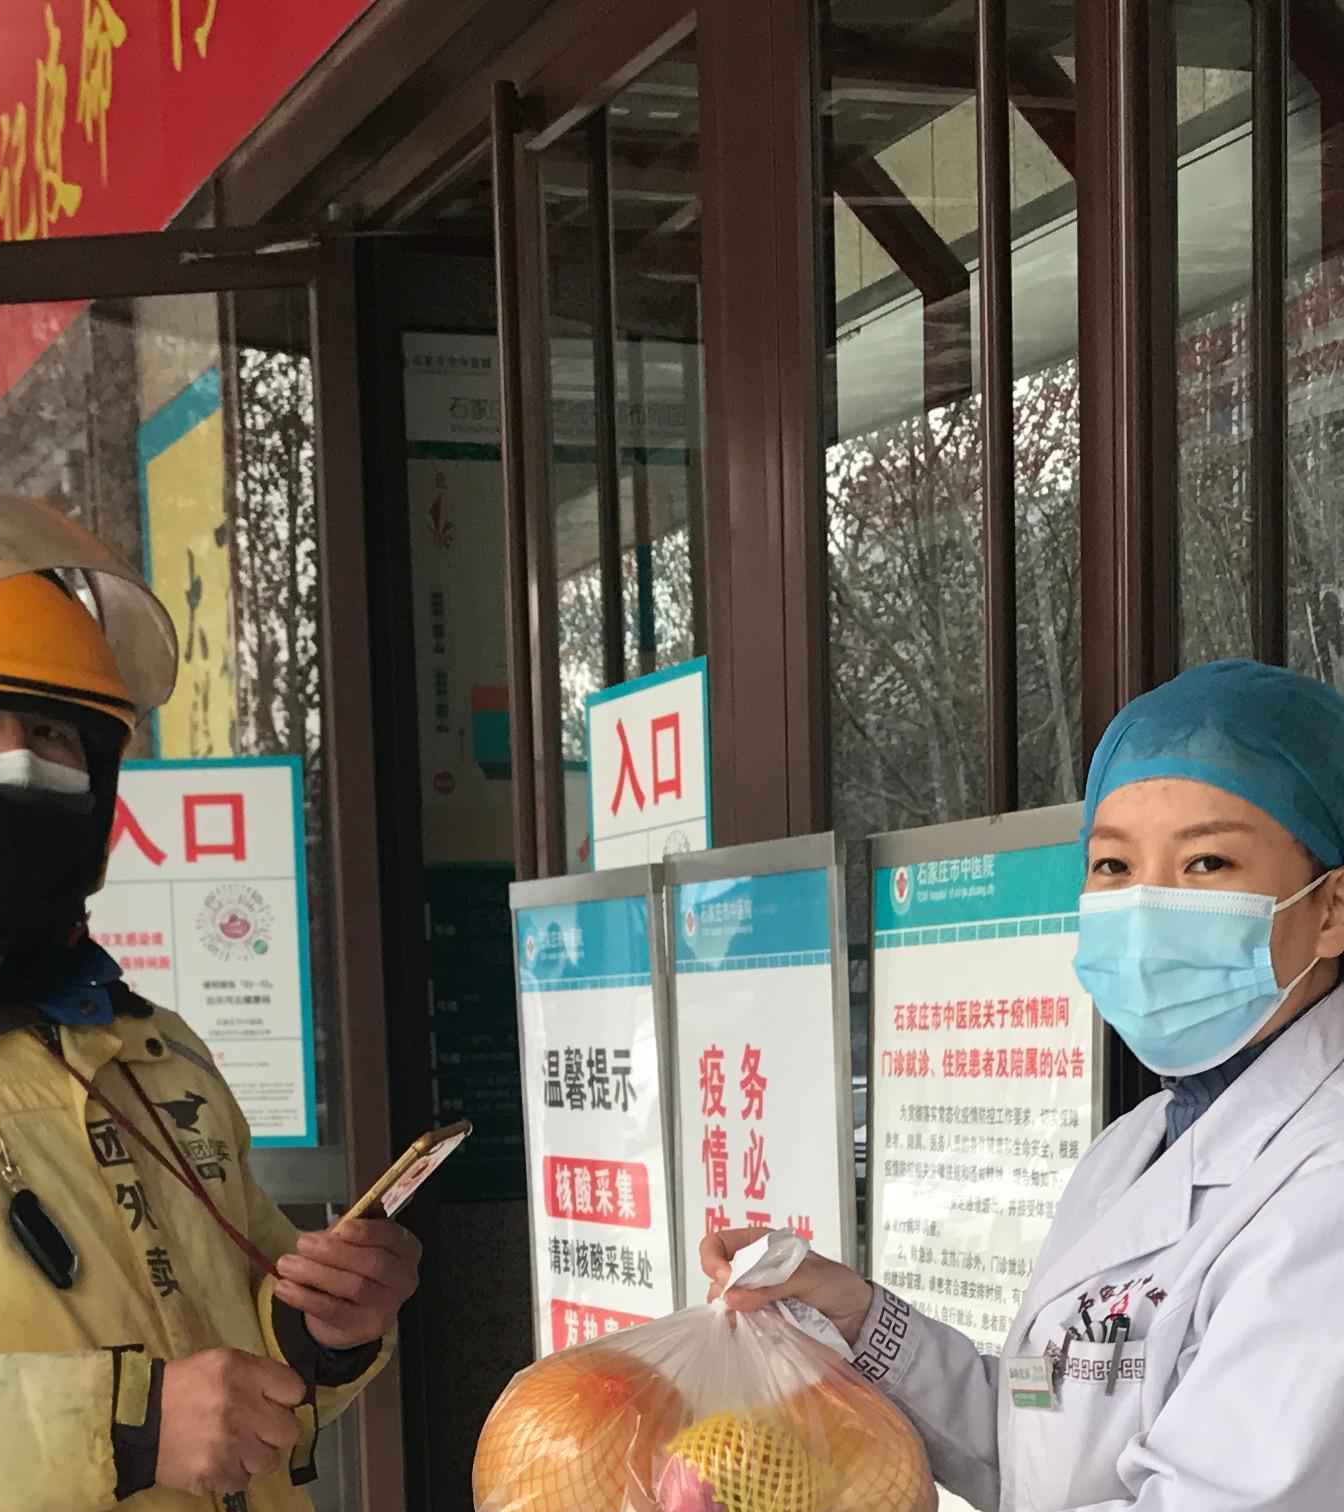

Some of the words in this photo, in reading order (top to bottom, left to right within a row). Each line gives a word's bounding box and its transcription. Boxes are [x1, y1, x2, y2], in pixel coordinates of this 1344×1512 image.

[610, 711, 683, 818] 入口
[109, 792, 248, 867] 入口
[893, 996, 1070, 1033] 石家庄市中医院关于疫情期间
[542, 1046, 638, 1112] 温馨提示
[554, 1163, 639, 1221] 核酸采集
[547, 1236, 654, 1290] 请到核酸采集处
[564, 1308, 639, 1347] 发热
